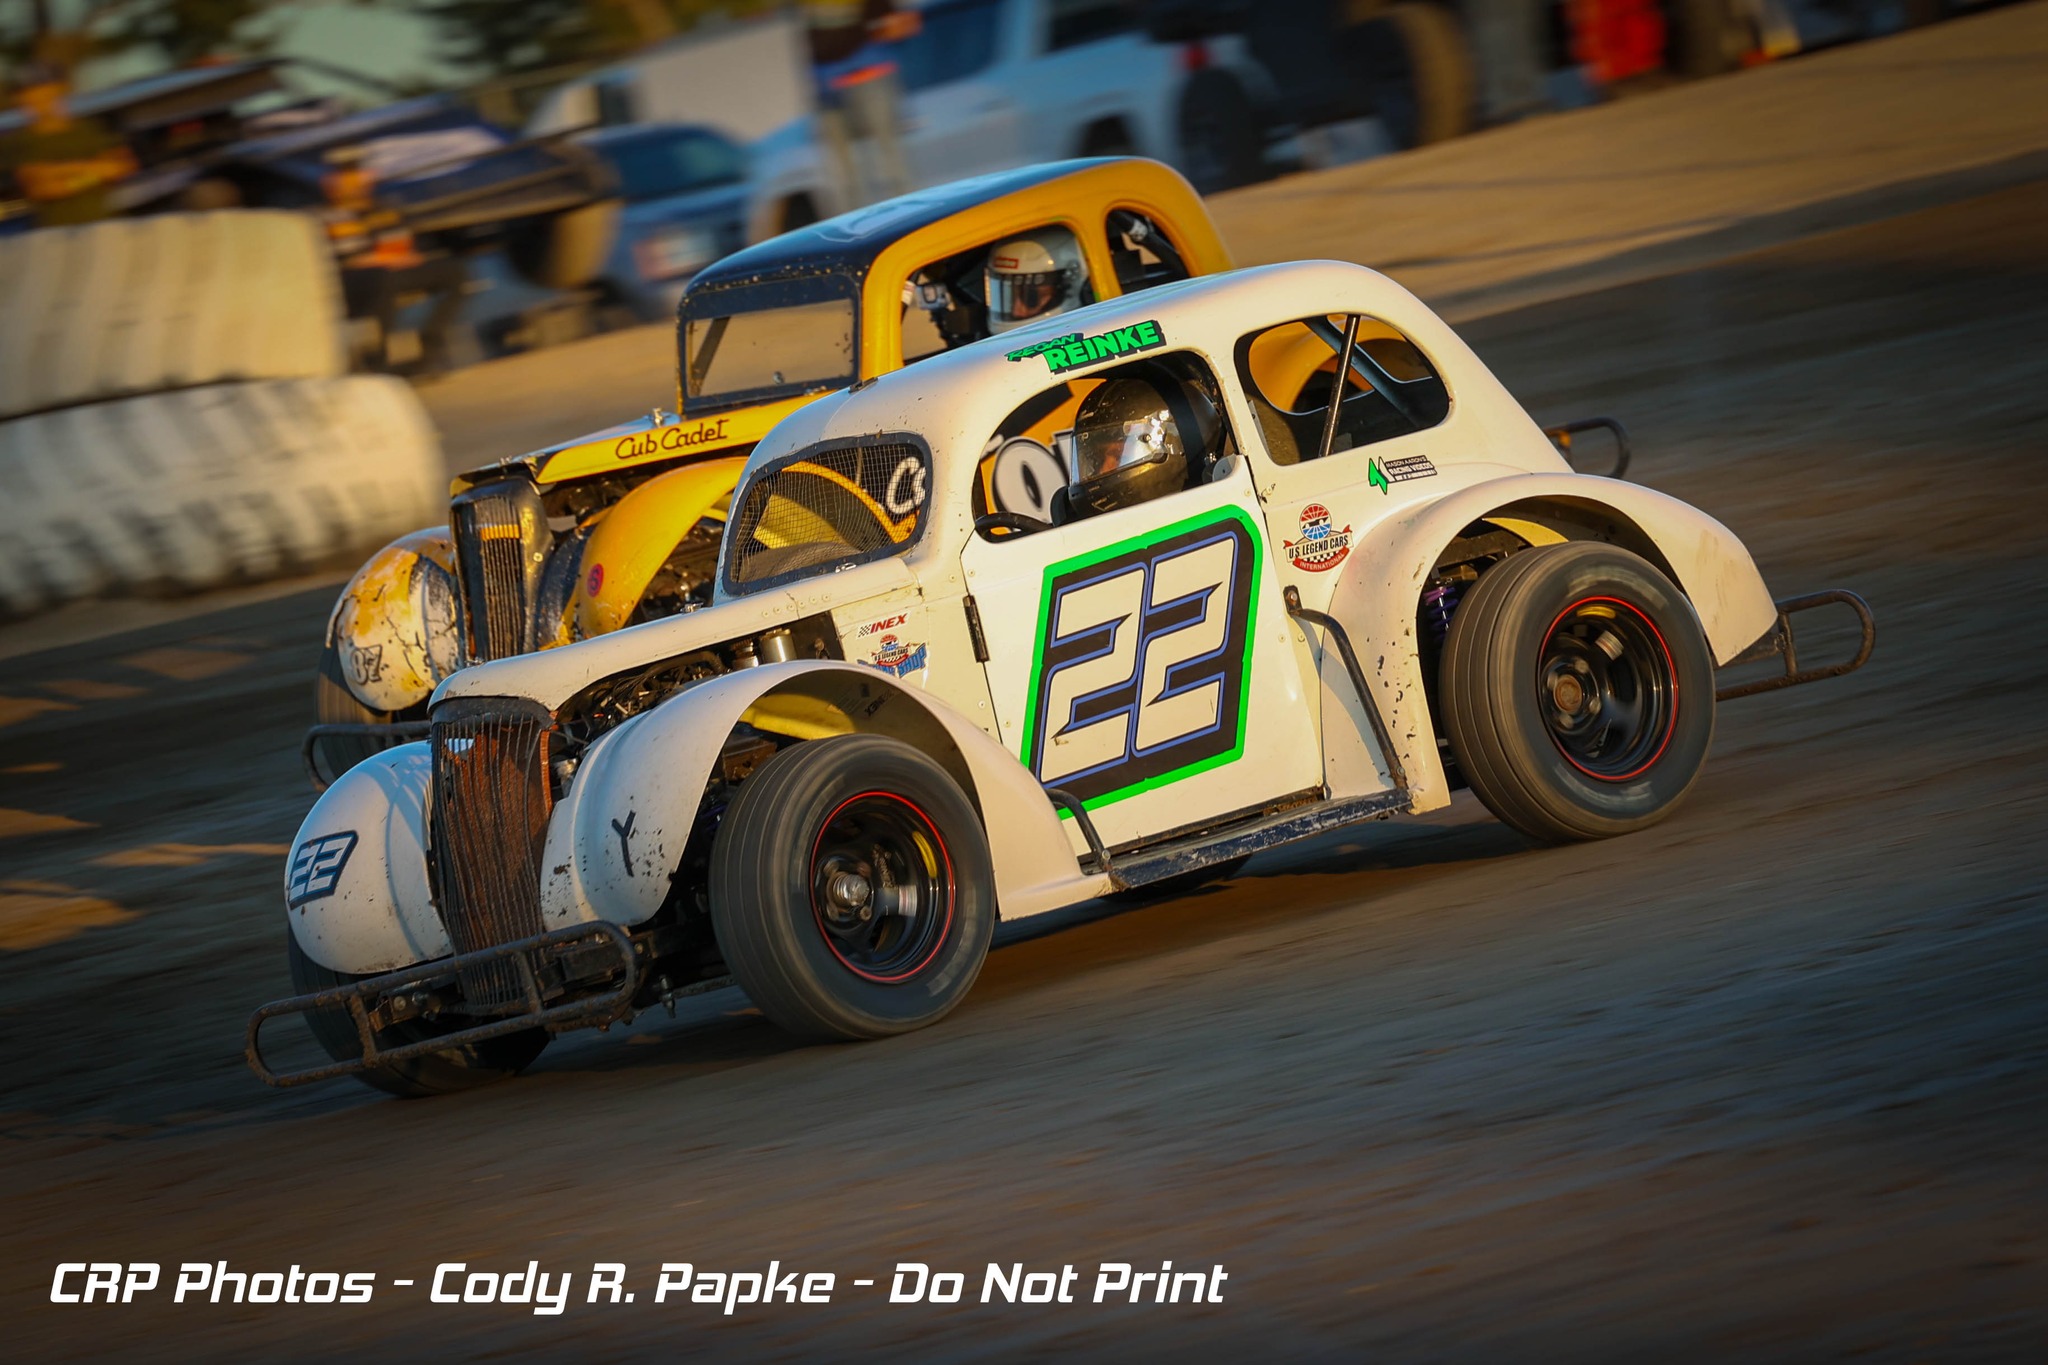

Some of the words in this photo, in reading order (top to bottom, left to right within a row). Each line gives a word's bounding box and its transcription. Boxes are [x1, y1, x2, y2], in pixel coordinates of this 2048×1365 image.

[1005, 333, 1077, 361] REGAN
[1043, 320, 1162, 373] REINKE
[615, 433, 658, 460] Cub
[661, 419, 730, 450] Cadet
[1299, 552, 1345, 571] INTERNATIONAL
[1302, 539, 1329, 556] LEGEND
[1329, 534, 1349, 550] CARS
[869, 612, 908, 634] INEX
[1037, 531, 1239, 789] 22
[288, 833, 355, 905] 22
